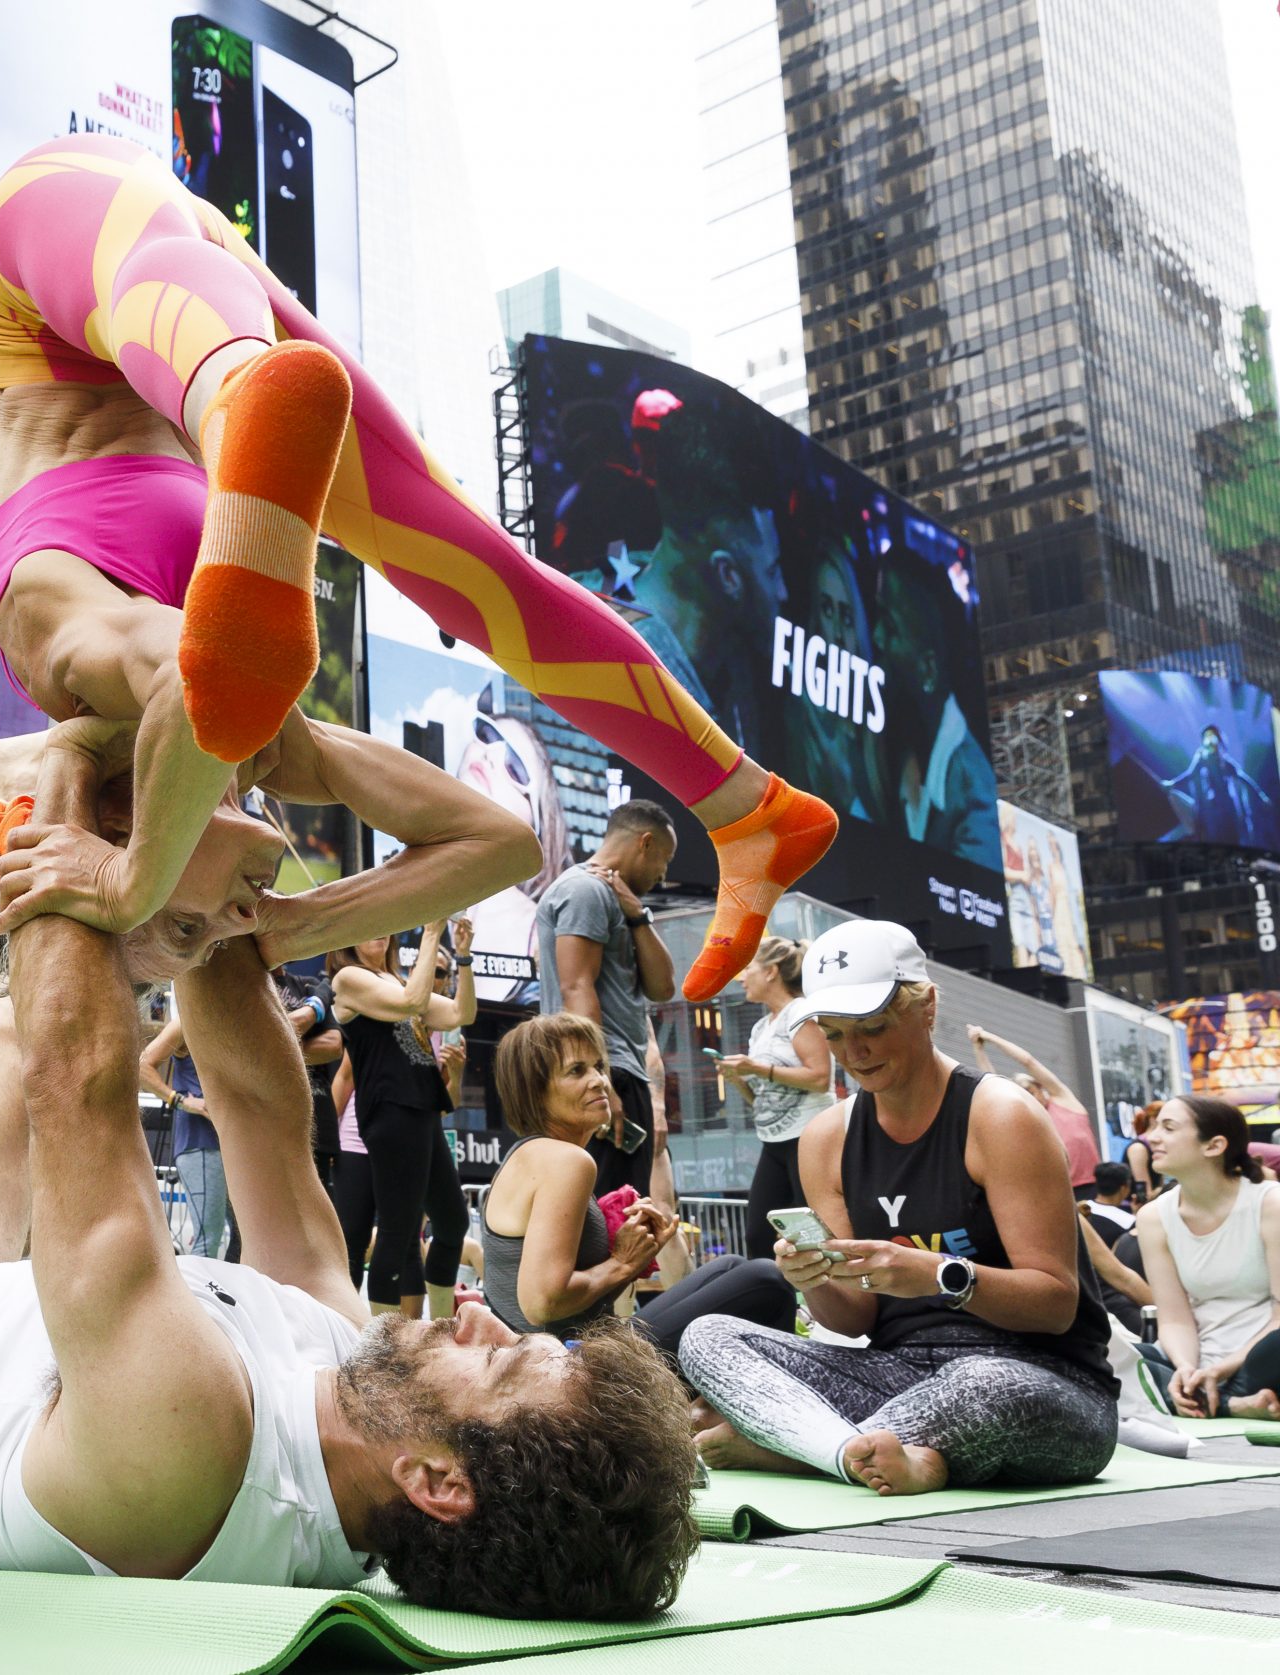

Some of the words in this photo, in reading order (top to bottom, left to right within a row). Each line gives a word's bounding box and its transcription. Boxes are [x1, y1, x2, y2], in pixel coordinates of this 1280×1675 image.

[192, 66, 222, 94] 7:30
[772, 616, 885, 734] FIGHTS
[1255, 883, 1277, 952] 1500
[878, 1195, 907, 1228] Y
